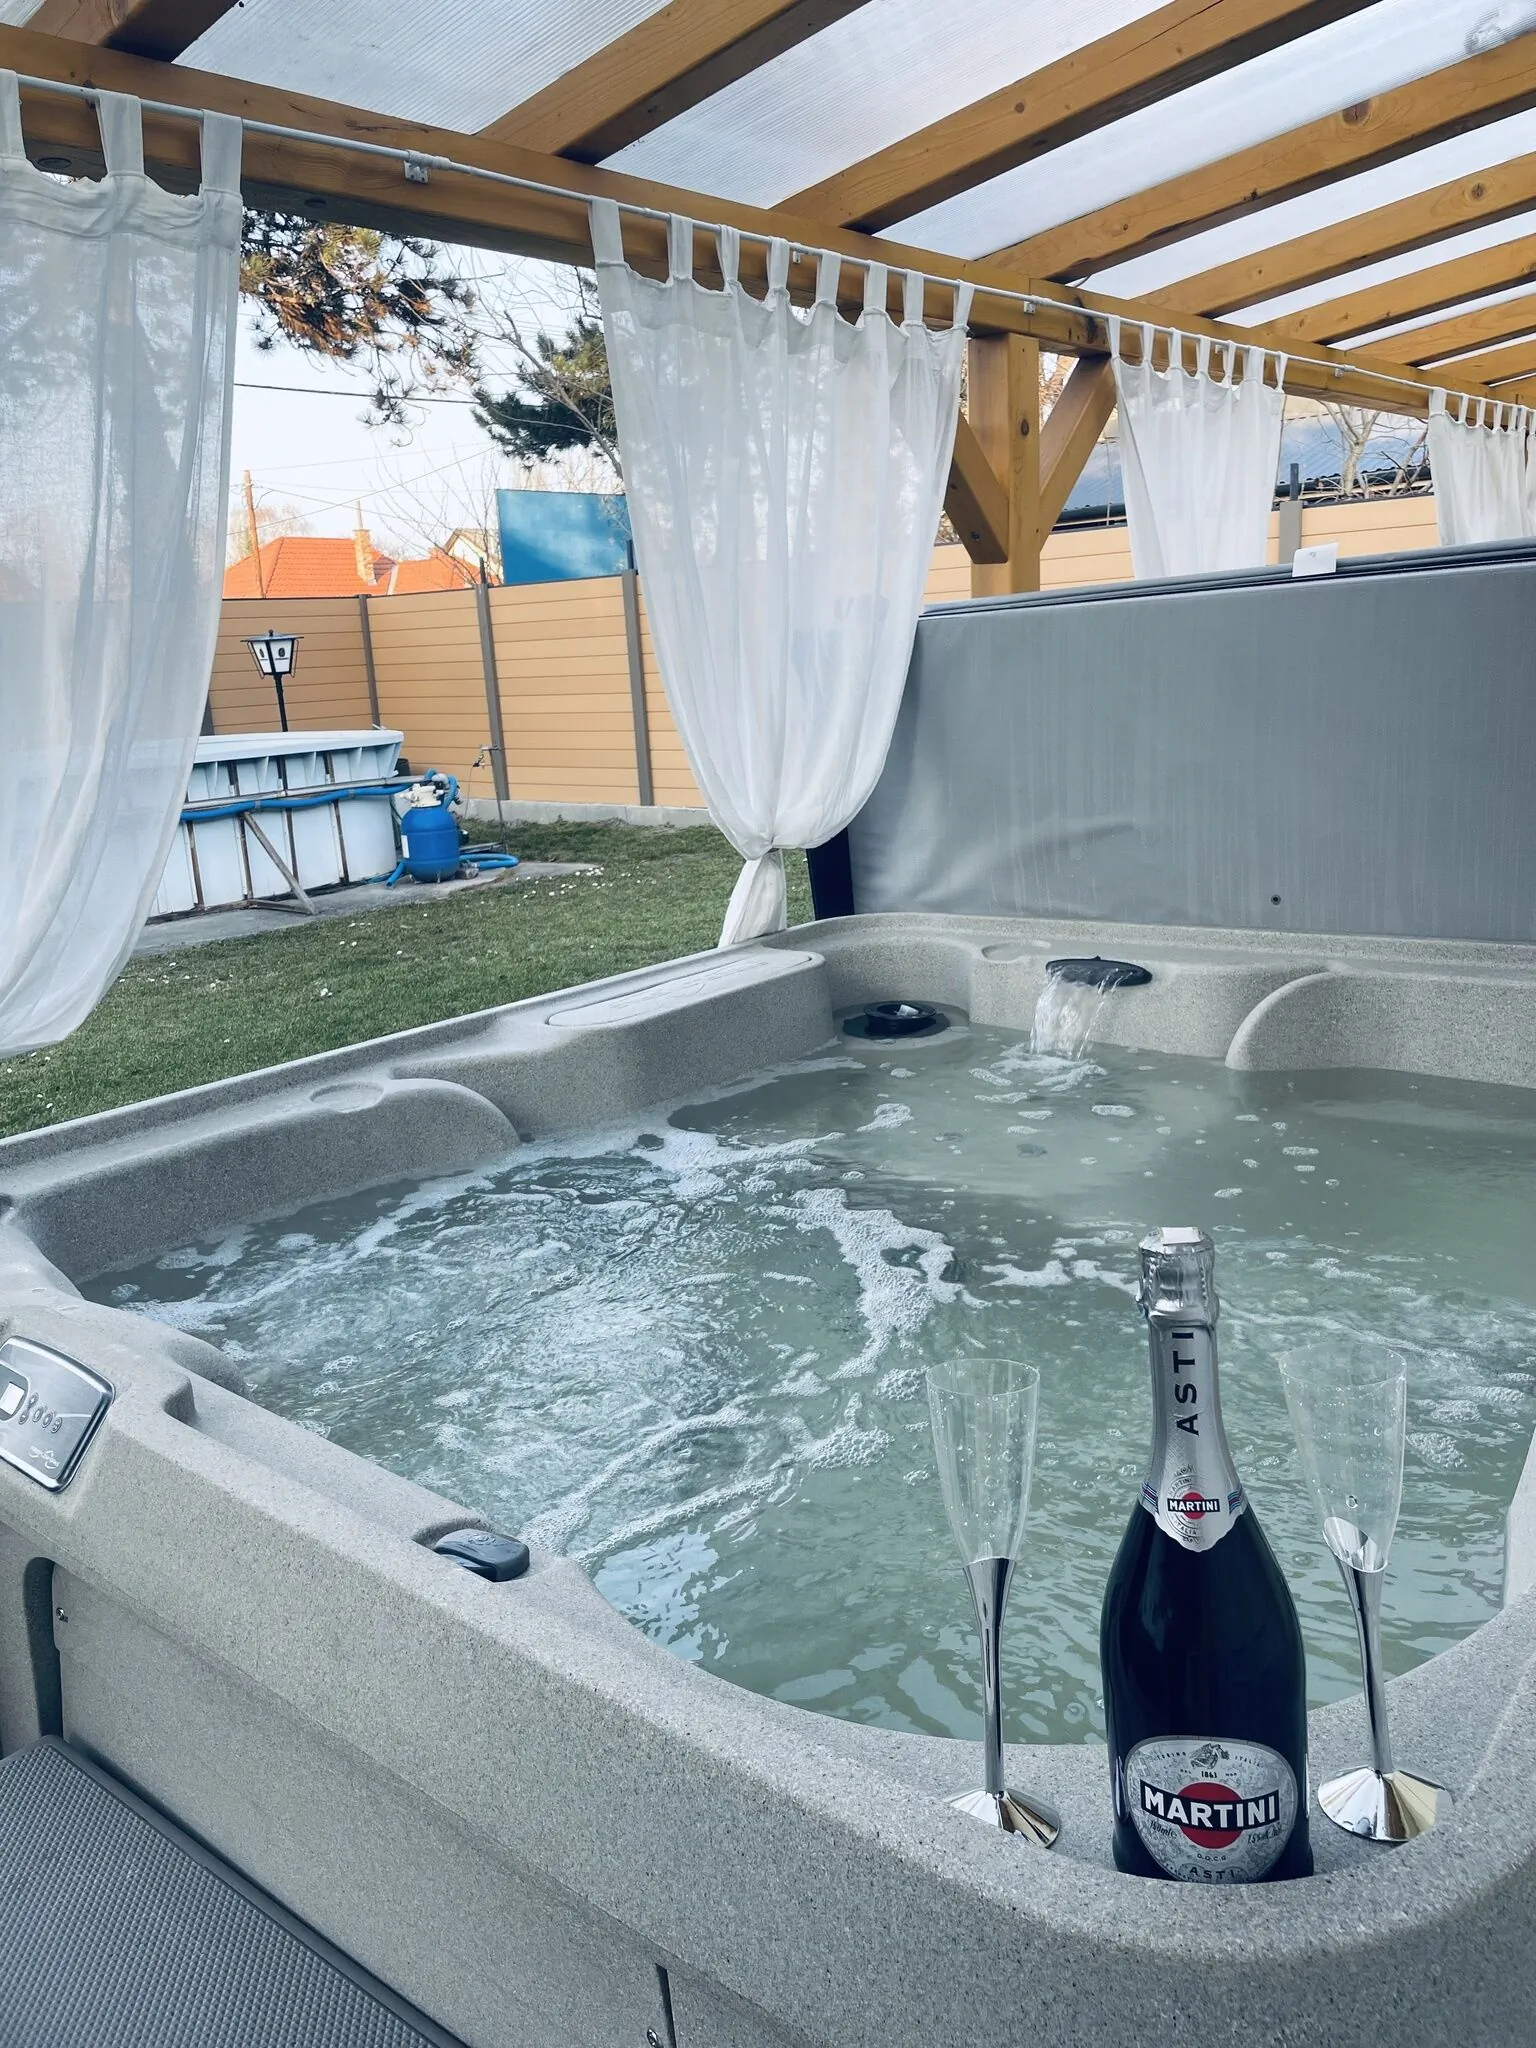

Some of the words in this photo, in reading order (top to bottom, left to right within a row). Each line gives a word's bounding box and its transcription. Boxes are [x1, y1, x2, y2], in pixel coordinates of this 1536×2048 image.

[1172, 1331, 1199, 1436] ASTI
[1168, 1499, 1219, 1512] MARTINI
[1144, 1785, 1275, 1829] MARTINI
[1189, 1866, 1236, 1879] ASTI
